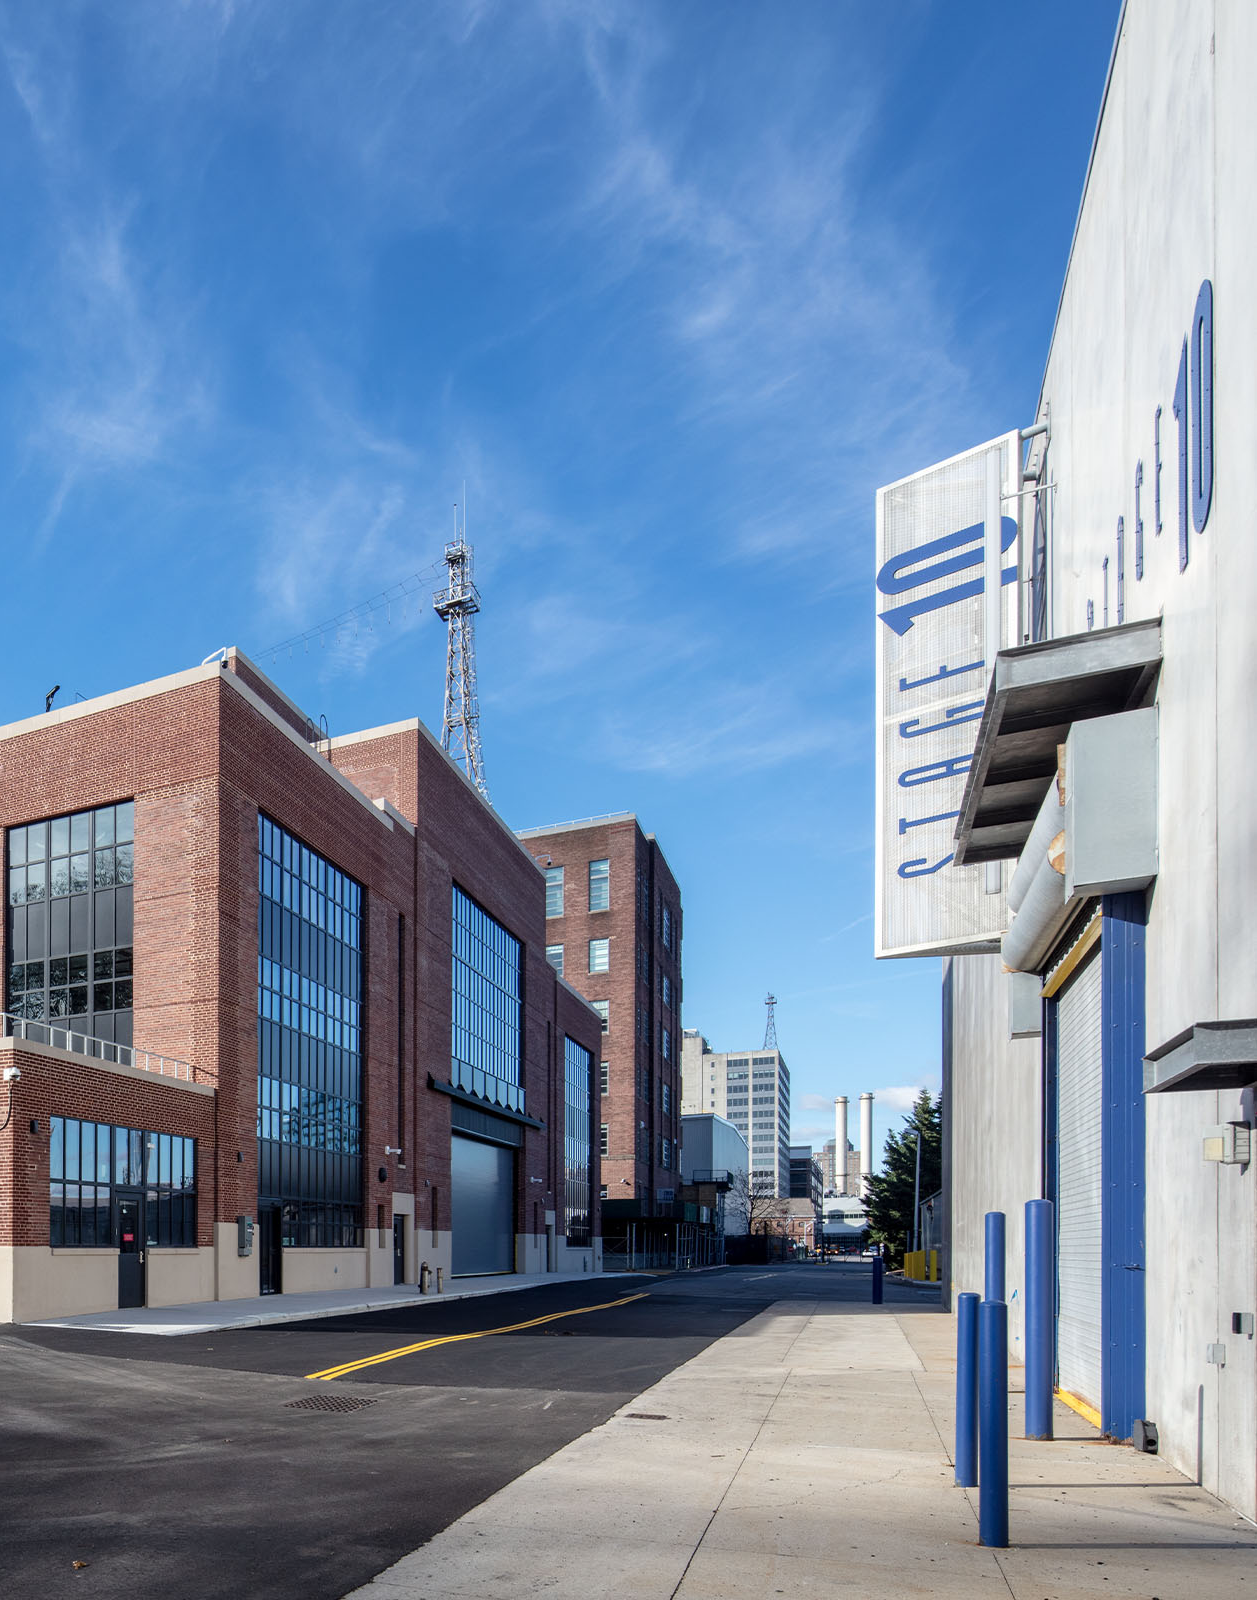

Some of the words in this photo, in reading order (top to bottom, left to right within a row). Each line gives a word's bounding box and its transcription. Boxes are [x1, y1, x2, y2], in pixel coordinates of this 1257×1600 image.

[1172, 279, 1214, 574] 10
[876, 516, 1018, 636] 10
[897, 659, 985, 878] STAGE
